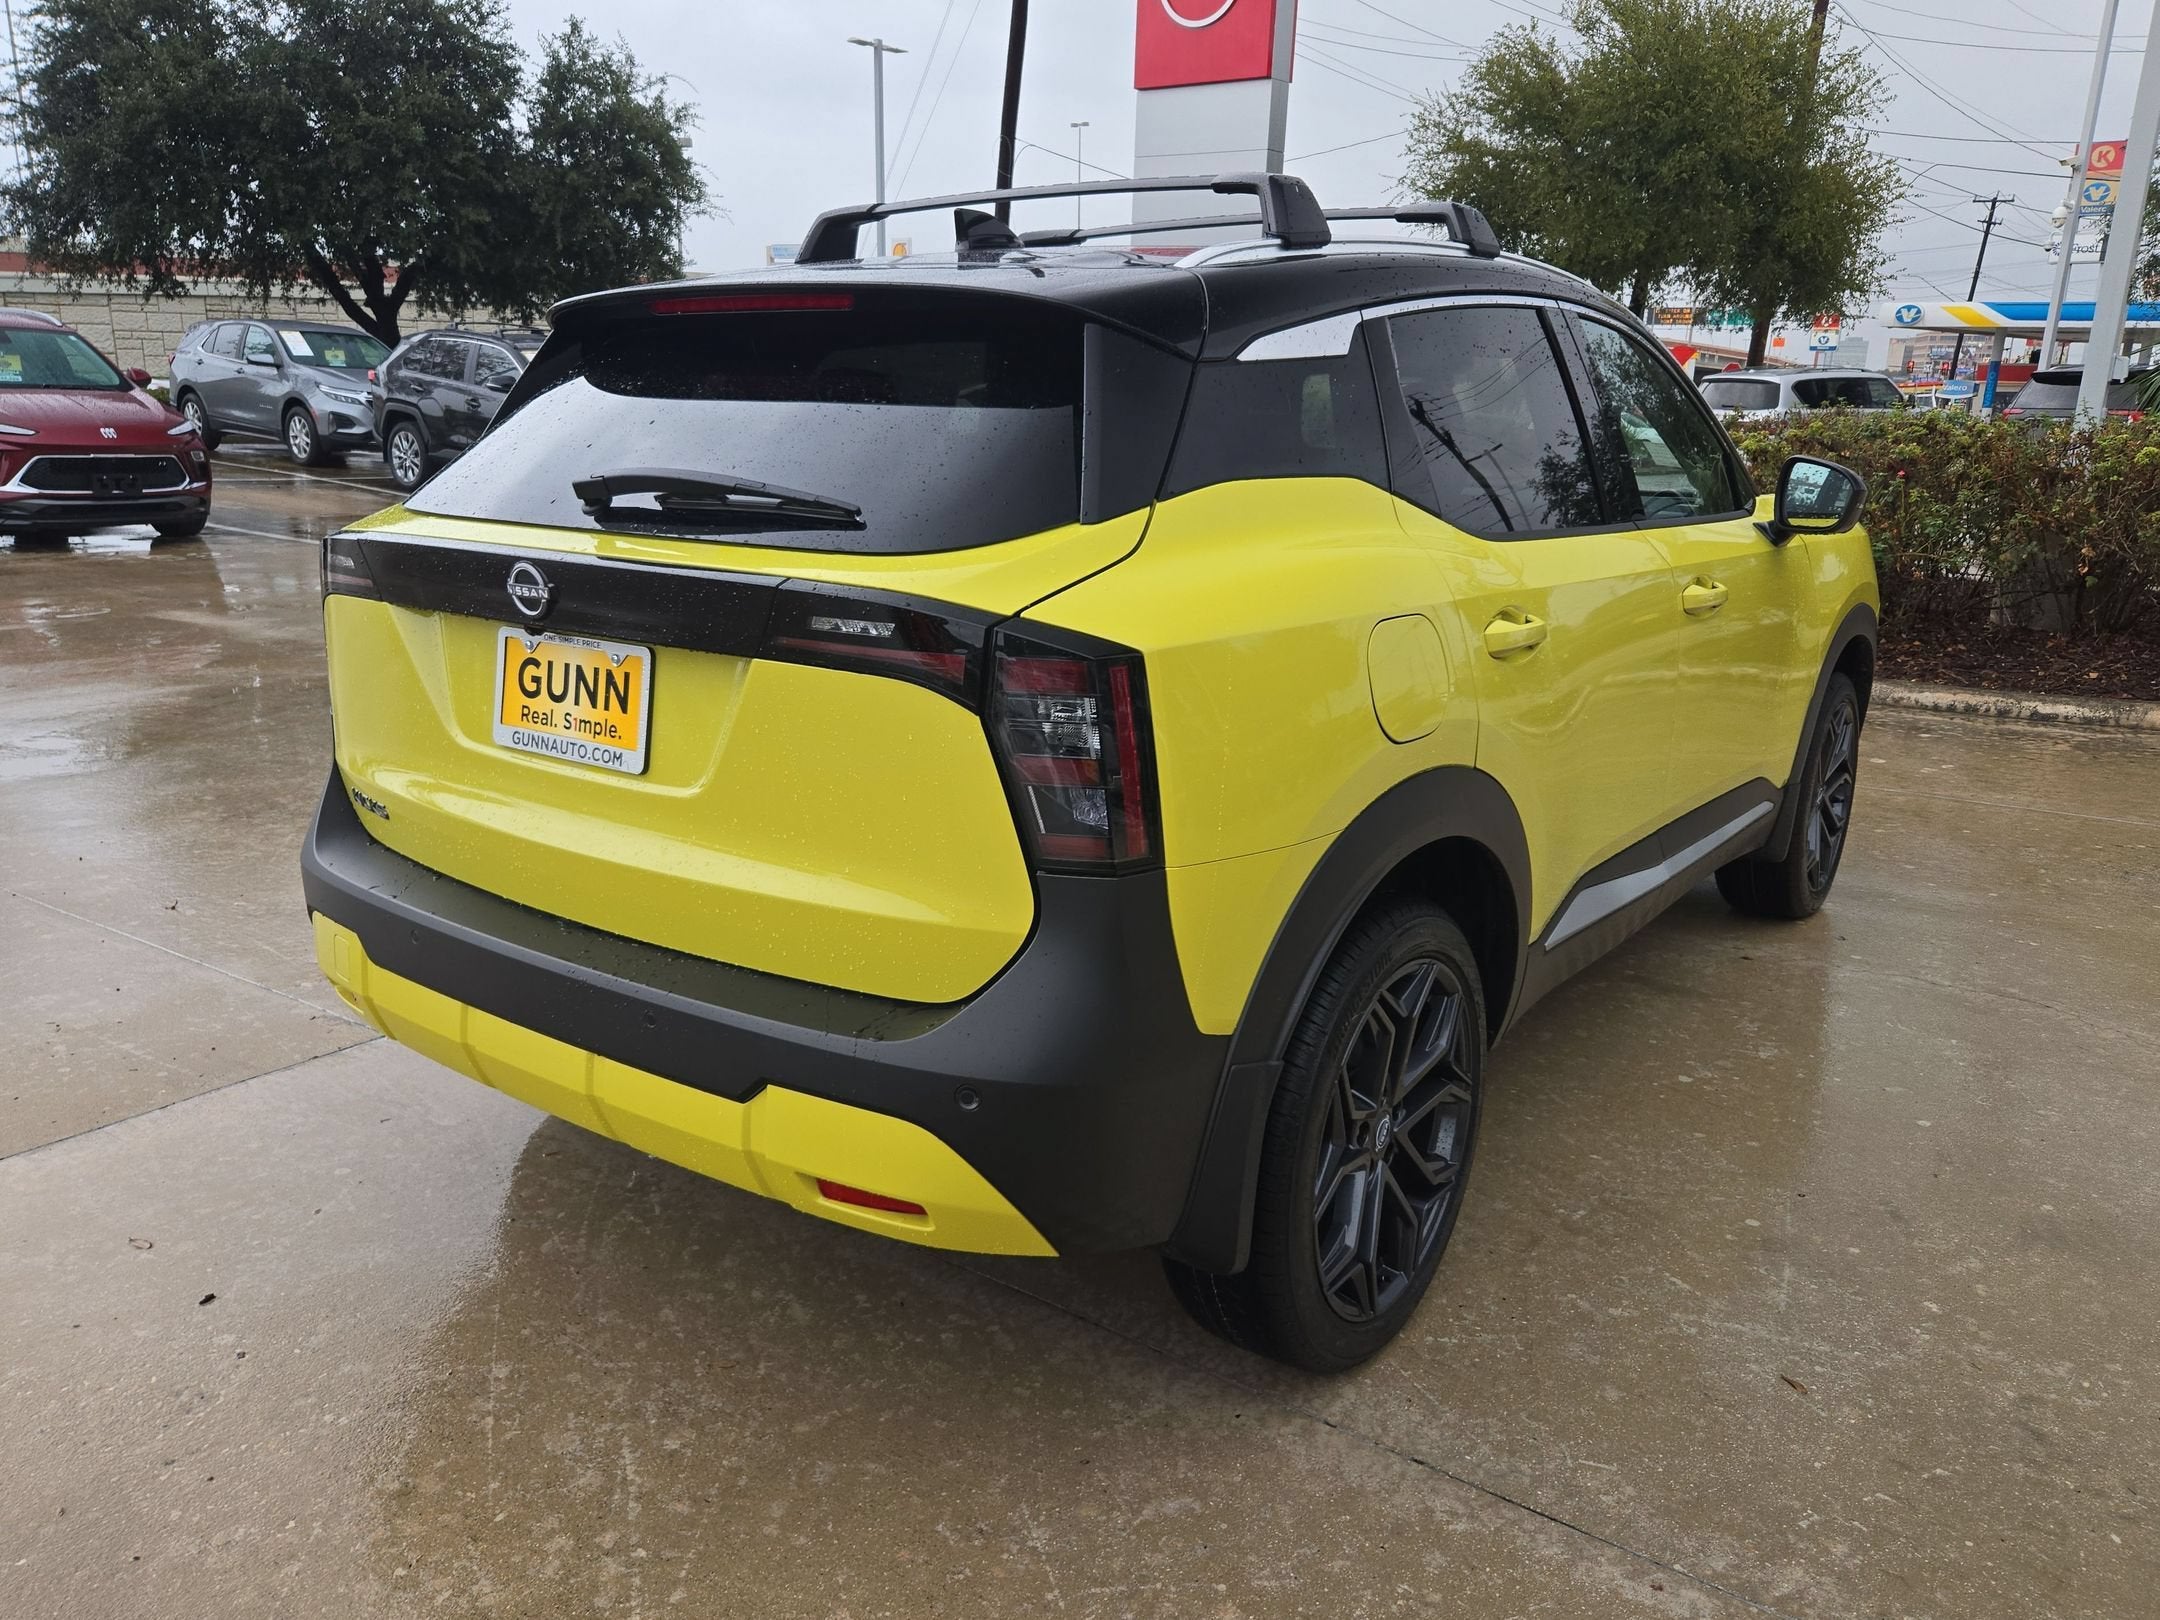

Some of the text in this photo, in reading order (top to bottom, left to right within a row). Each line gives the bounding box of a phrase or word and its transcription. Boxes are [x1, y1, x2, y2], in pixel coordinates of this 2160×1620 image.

[507, 584, 549, 599] NISSAN
[544, 633, 601, 649] ONE SIMPLE PRICE
[517, 657, 631, 715] GUNN
[520, 705, 558, 728] Real.
[512, 730, 623, 767] GUNNAUTO.COM
